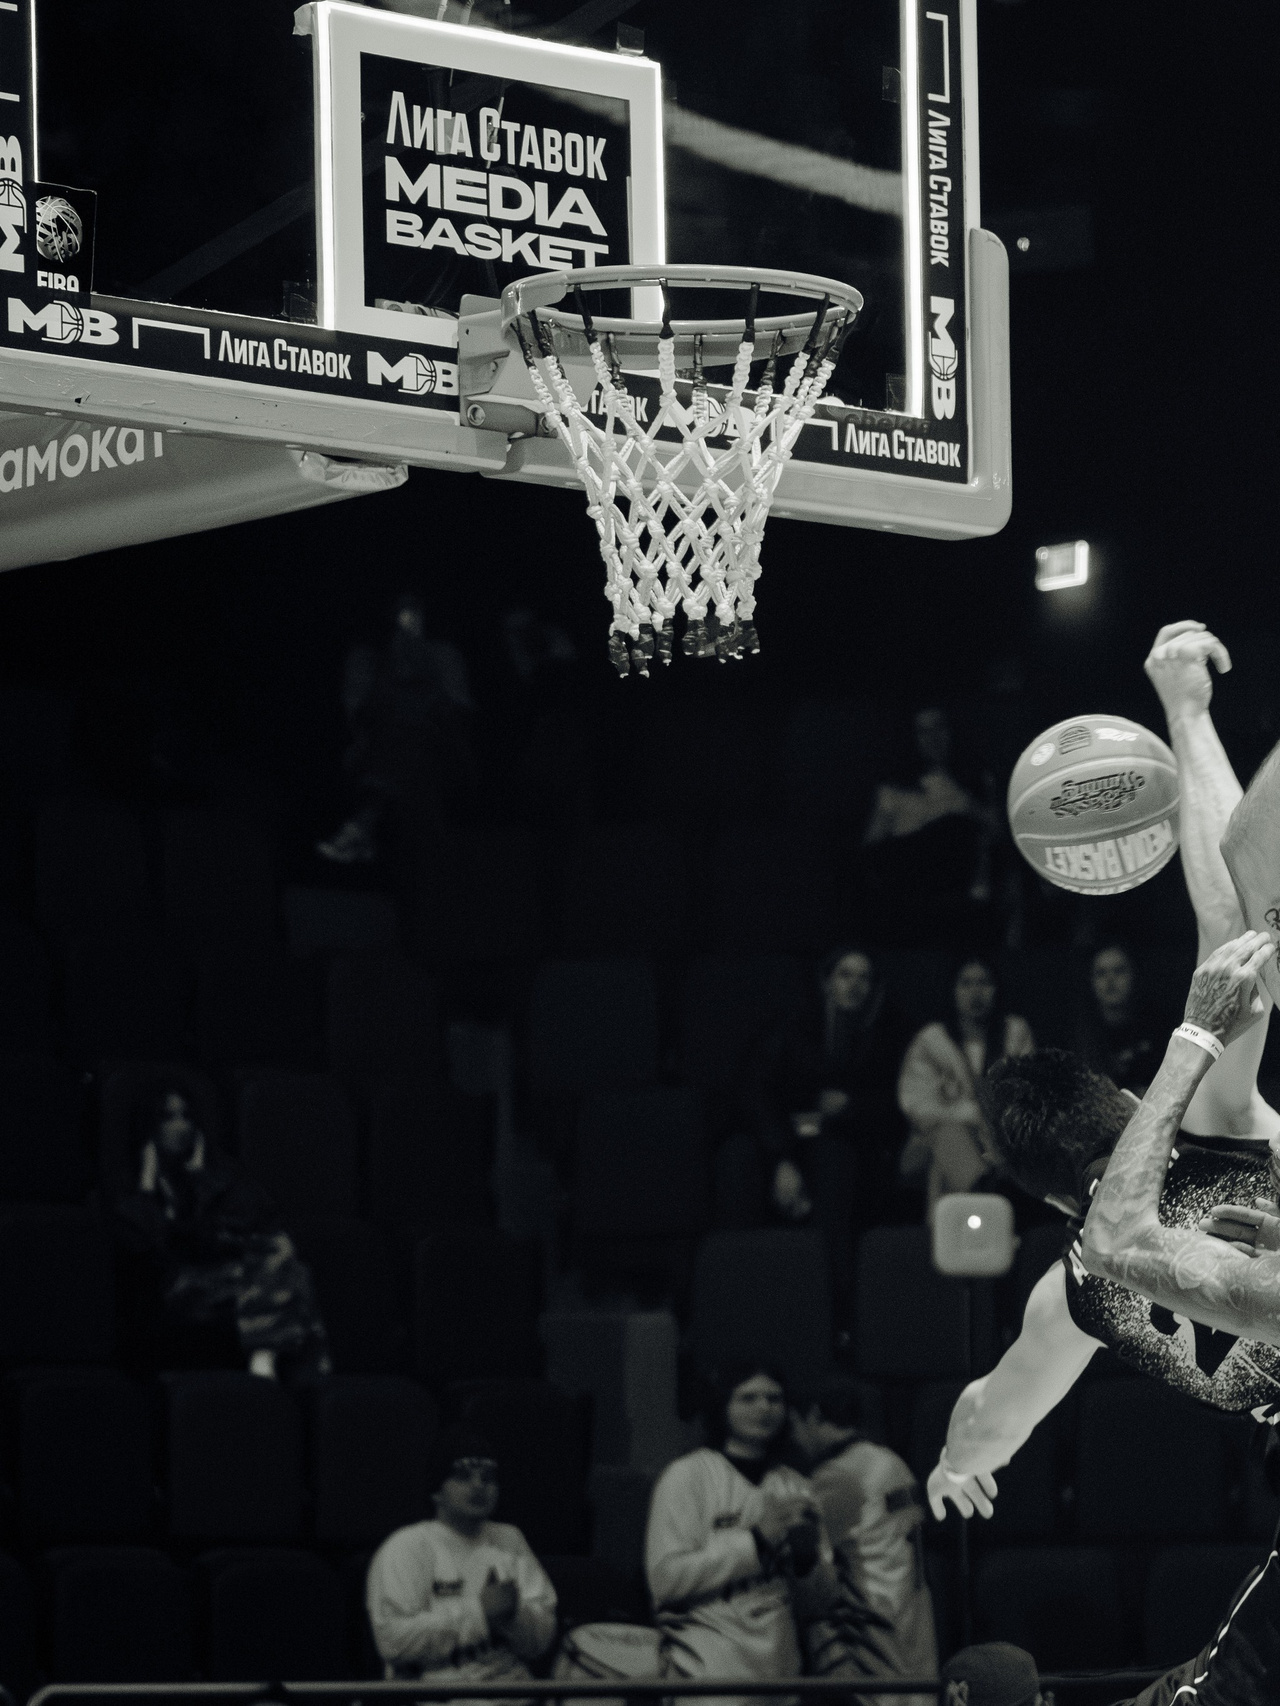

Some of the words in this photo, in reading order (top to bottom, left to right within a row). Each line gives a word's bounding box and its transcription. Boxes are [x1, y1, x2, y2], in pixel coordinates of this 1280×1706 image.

[386, 90, 473, 158] ЛИГА
[479, 107, 608, 181] СТАВОК
[385, 155, 608, 236] MEDIA
[386, 209, 609, 271] BASKET
[218, 330, 271, 369] ЛИГА
[273, 338, 352, 380] СТАВОК
[844, 423, 890, 458] ЛИГА
[892, 429, 962, 468] СТАВОК
